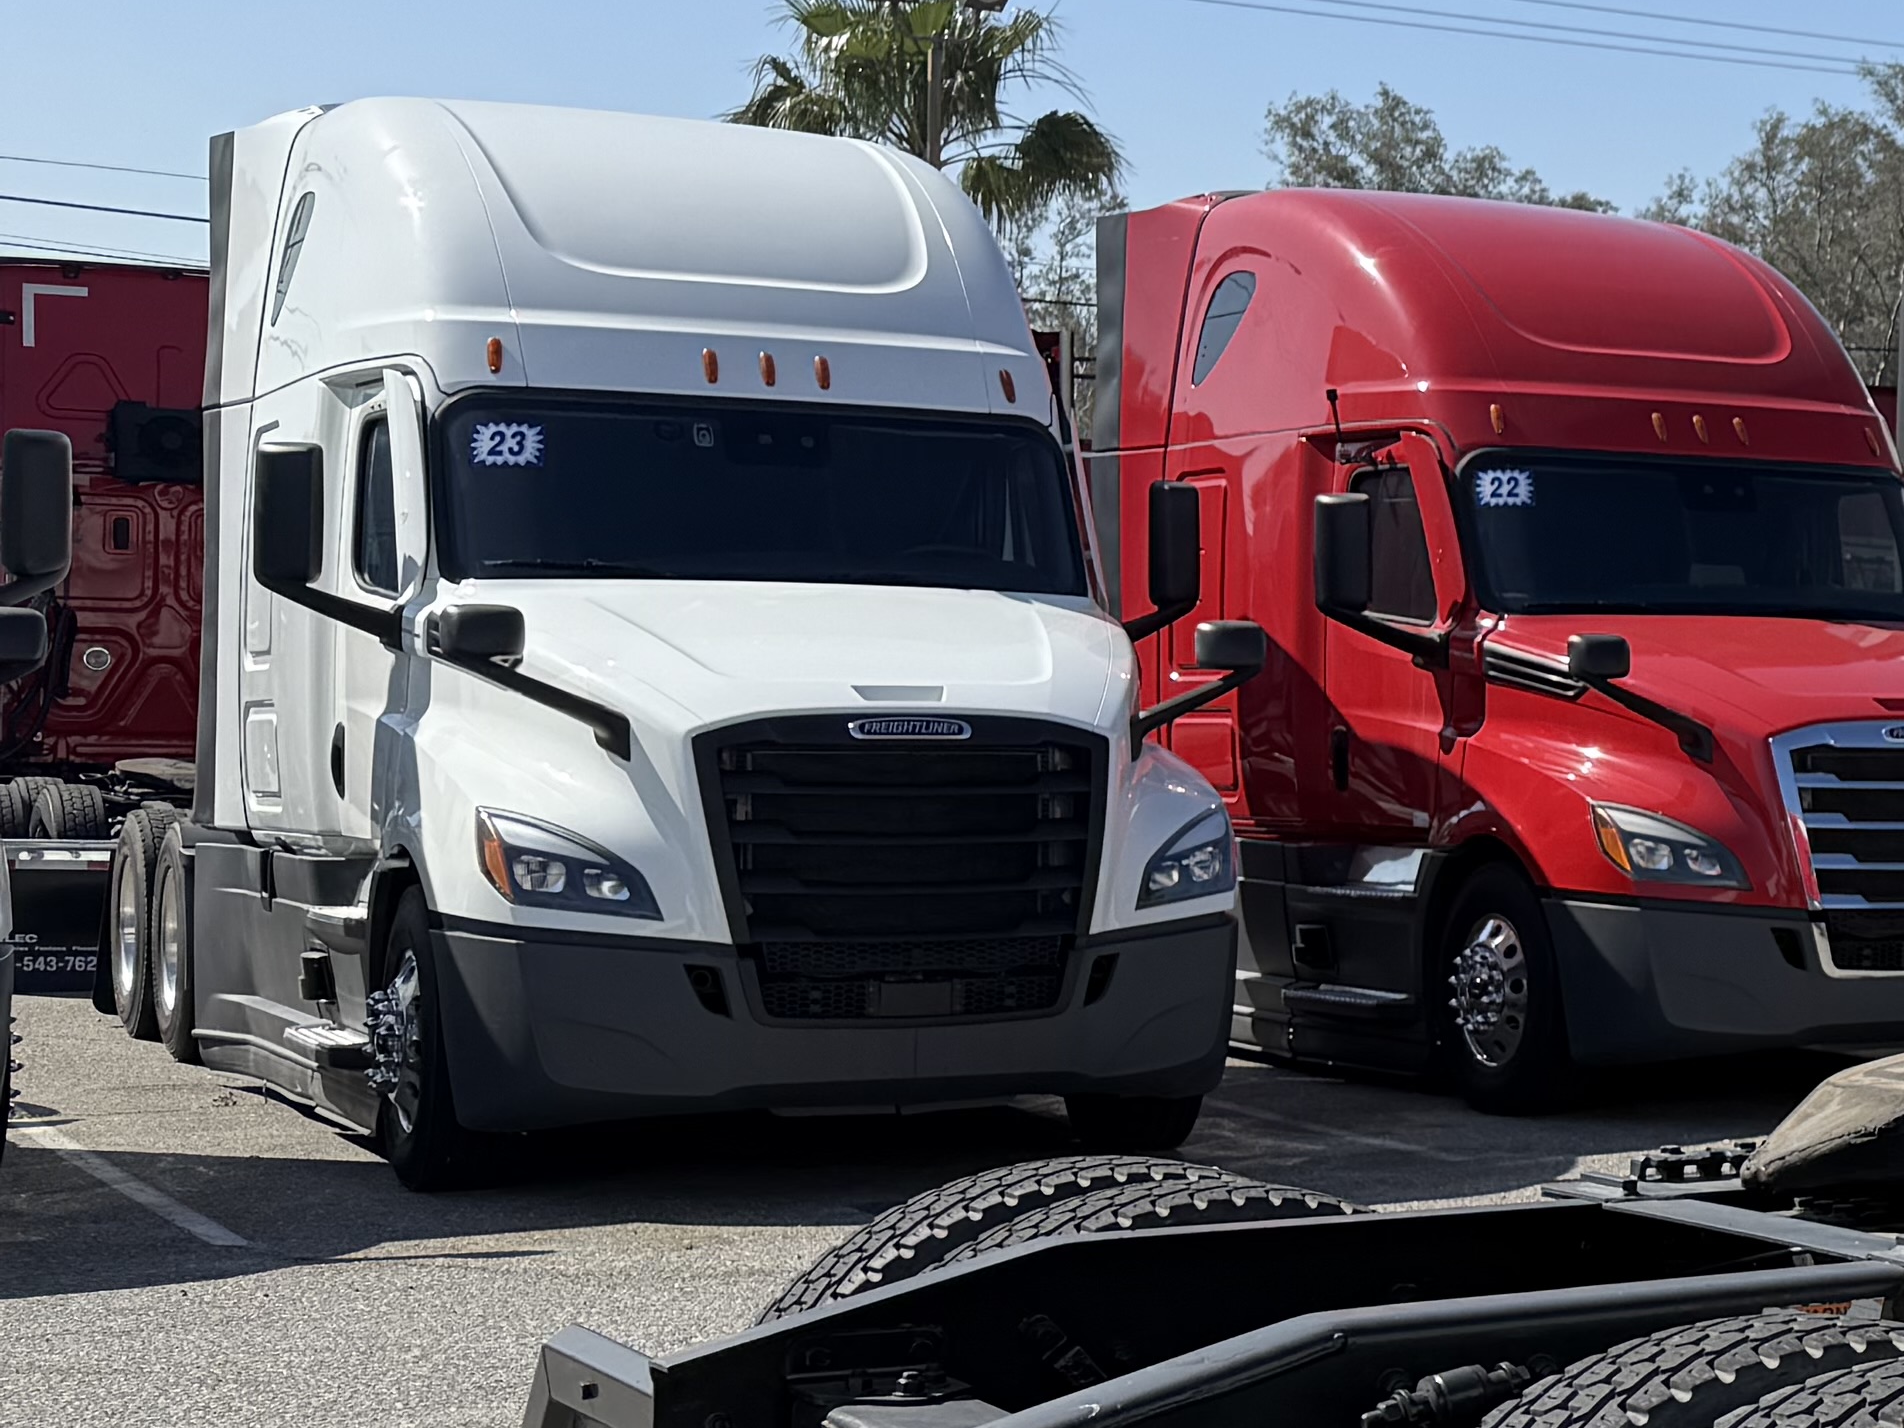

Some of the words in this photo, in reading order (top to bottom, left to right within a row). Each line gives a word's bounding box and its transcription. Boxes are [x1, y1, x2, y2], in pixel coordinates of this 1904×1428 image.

[487, 430, 526, 456] 23
[1490, 476, 1520, 498] 22
[864, 721, 960, 734] FREIGHTLINER
